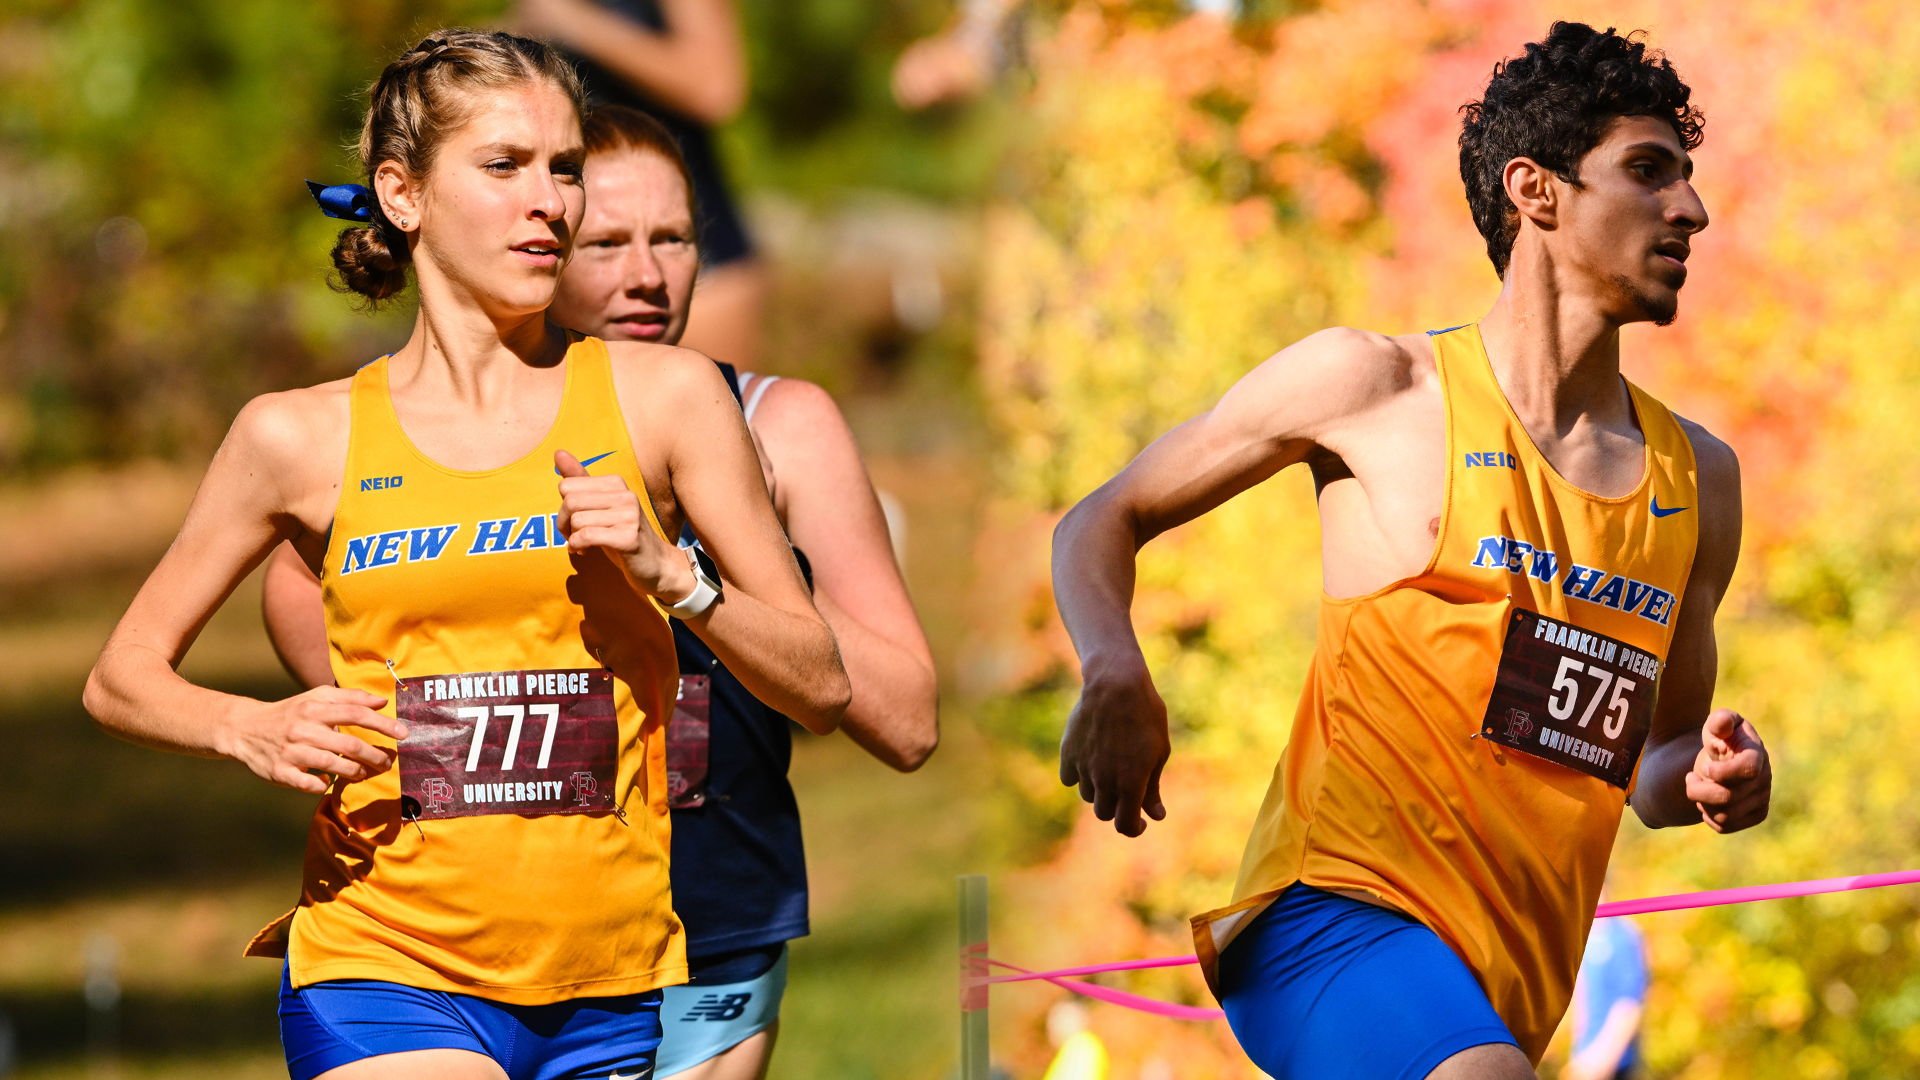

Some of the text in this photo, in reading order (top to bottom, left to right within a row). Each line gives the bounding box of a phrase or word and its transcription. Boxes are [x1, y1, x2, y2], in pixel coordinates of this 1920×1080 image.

[361, 476, 402, 492] NE10
[1465, 451, 1516, 471] NE10
[340, 513, 569, 576] NEW HAV
[1470, 535, 1558, 585] NEW
[1534, 619, 1660, 681] FRANKLIN PIERCE
[424, 672, 589, 701] FRANKLIN PIERCE
[1547, 656, 1637, 740] 575
[457, 703, 560, 772] 777
[1539, 726, 1615, 769] UNIVERSITY
[463, 780, 563, 803] UNIVERSITY
